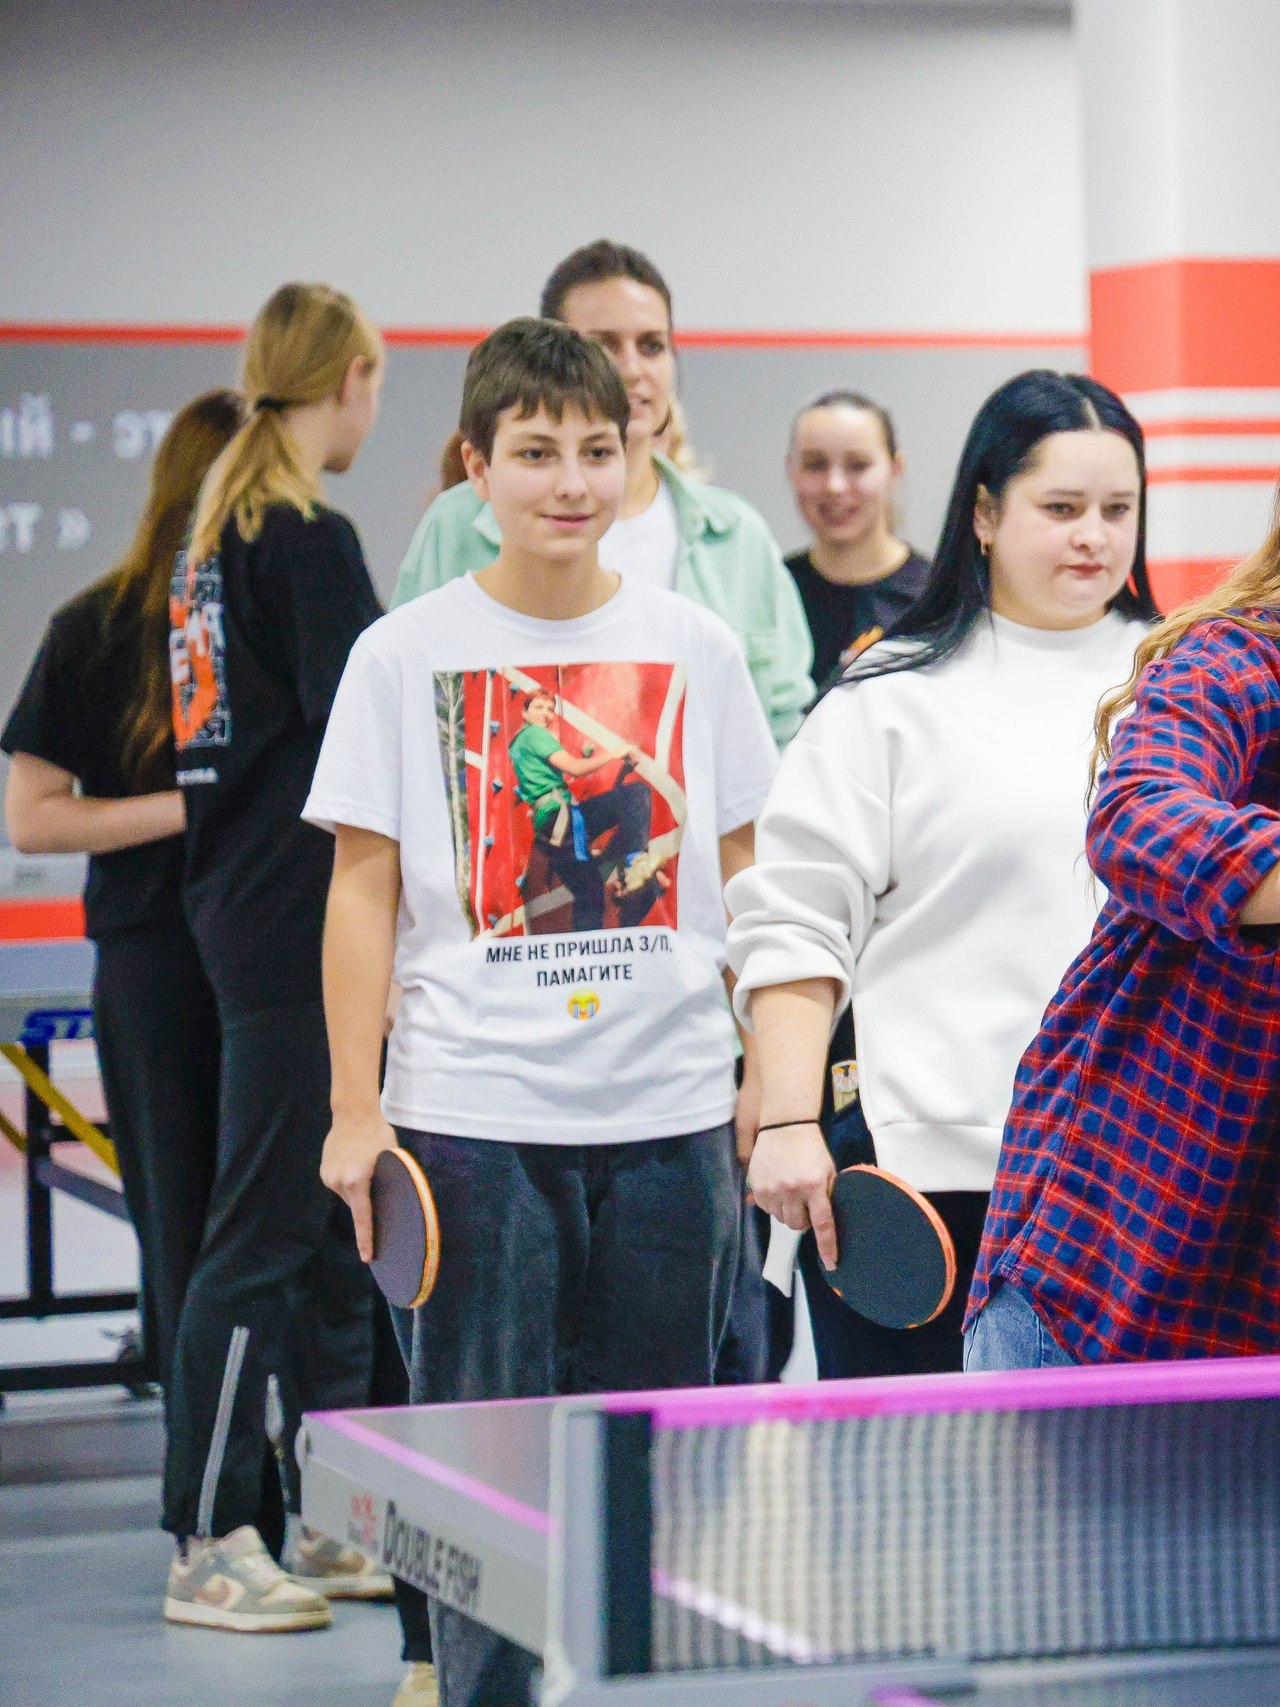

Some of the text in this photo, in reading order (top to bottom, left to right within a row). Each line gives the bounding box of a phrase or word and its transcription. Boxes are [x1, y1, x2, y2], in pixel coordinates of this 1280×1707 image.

[486, 945, 522, 963] МНЕ
[527, 943, 549, 960] НЕ
[555, 937, 634, 958] ПРИШЛА
[536, 963, 633, 987] ПАМАГИТЕ
[18, 1009, 97, 1046] ST
